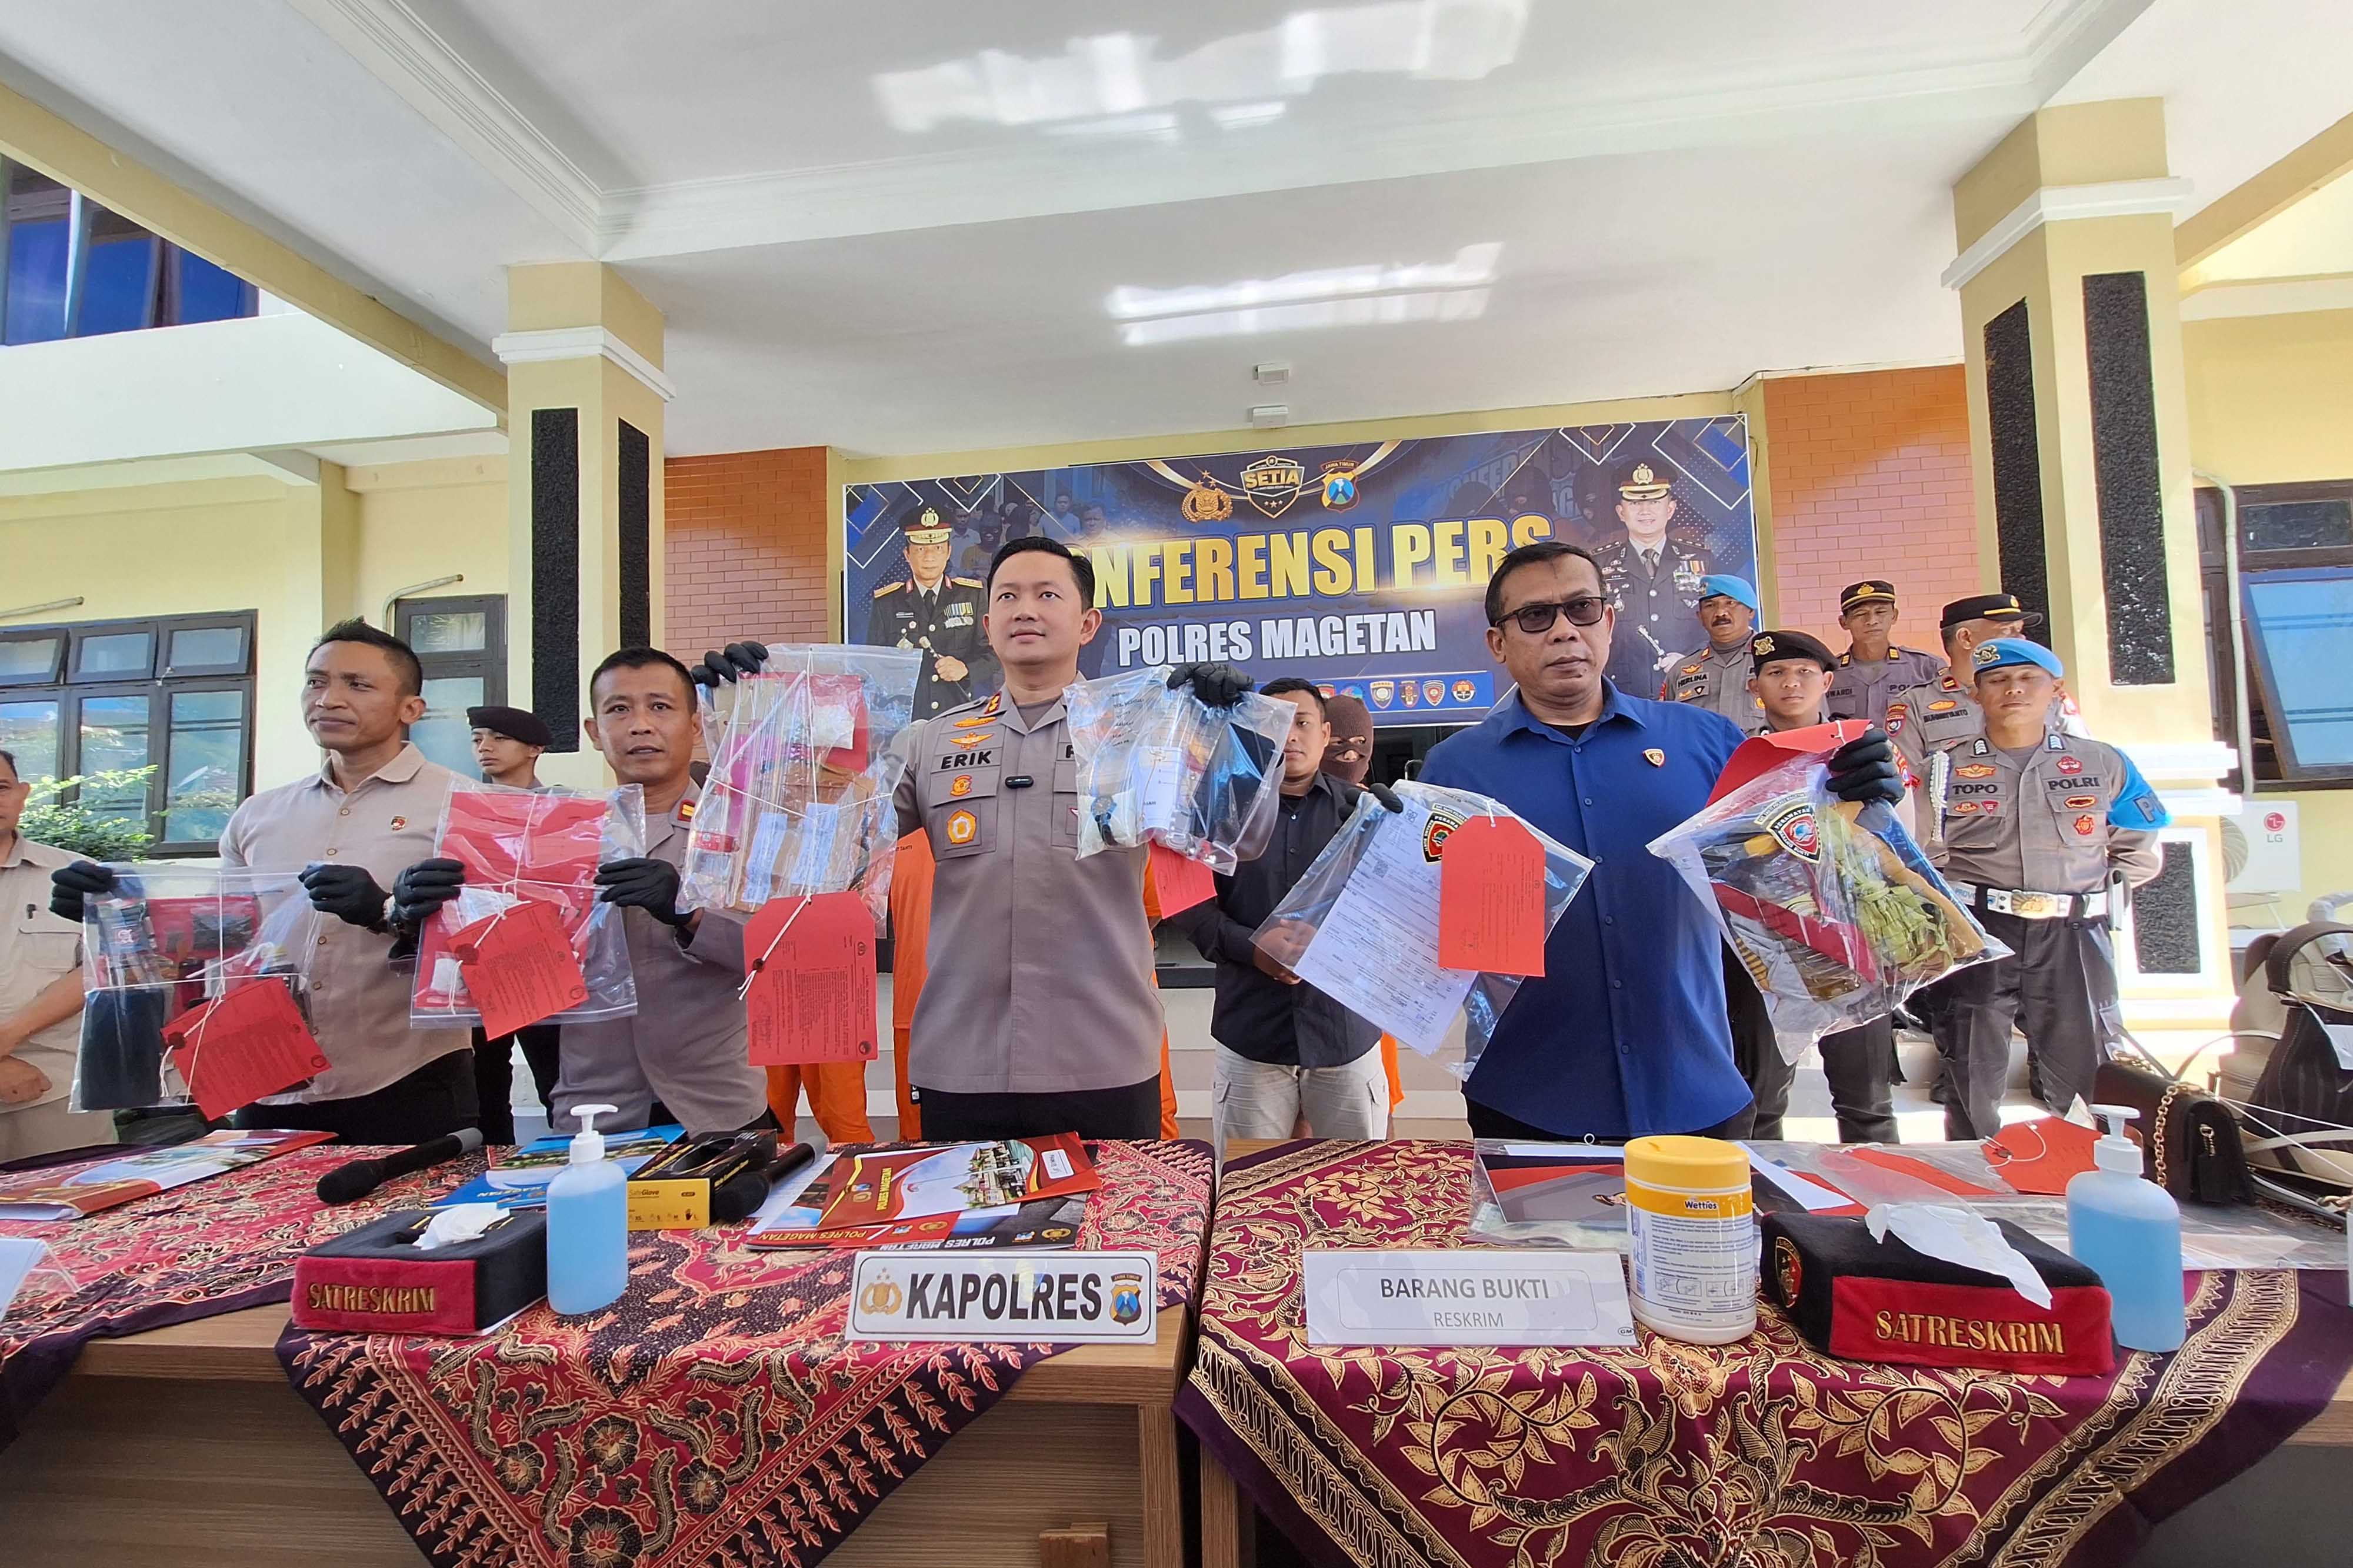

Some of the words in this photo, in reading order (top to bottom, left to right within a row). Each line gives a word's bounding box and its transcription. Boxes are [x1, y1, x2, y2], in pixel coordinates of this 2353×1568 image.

[1245, 469, 1300, 489] SETIA
[1118, 620, 1252, 666] POLRES
[1262, 610, 1436, 660] MAGETAN
[941, 750, 992, 769] ERIK
[1952, 784, 1998, 795] TOPO
[2047, 777, 2099, 791] POLRI
[2267, 834, 2283, 842] LG
[1685, 1200, 1717, 1209] Wetties
[758, 1232, 818, 1241] MAGETAN
[819, 1230, 867, 1239] POLRES
[944, 1236, 995, 1249] POLRES
[1381, 1278, 1475, 1298] BARANG
[1482, 1279, 1549, 1299] BUKTI
[308, 1283, 435, 1313] SATRESKRIM
[906, 1273, 1102, 1320] KAPOLRES
[1434, 1312, 1504, 1327] RESKRIM
[1876, 1310, 2065, 1353] SATRESKRIM
